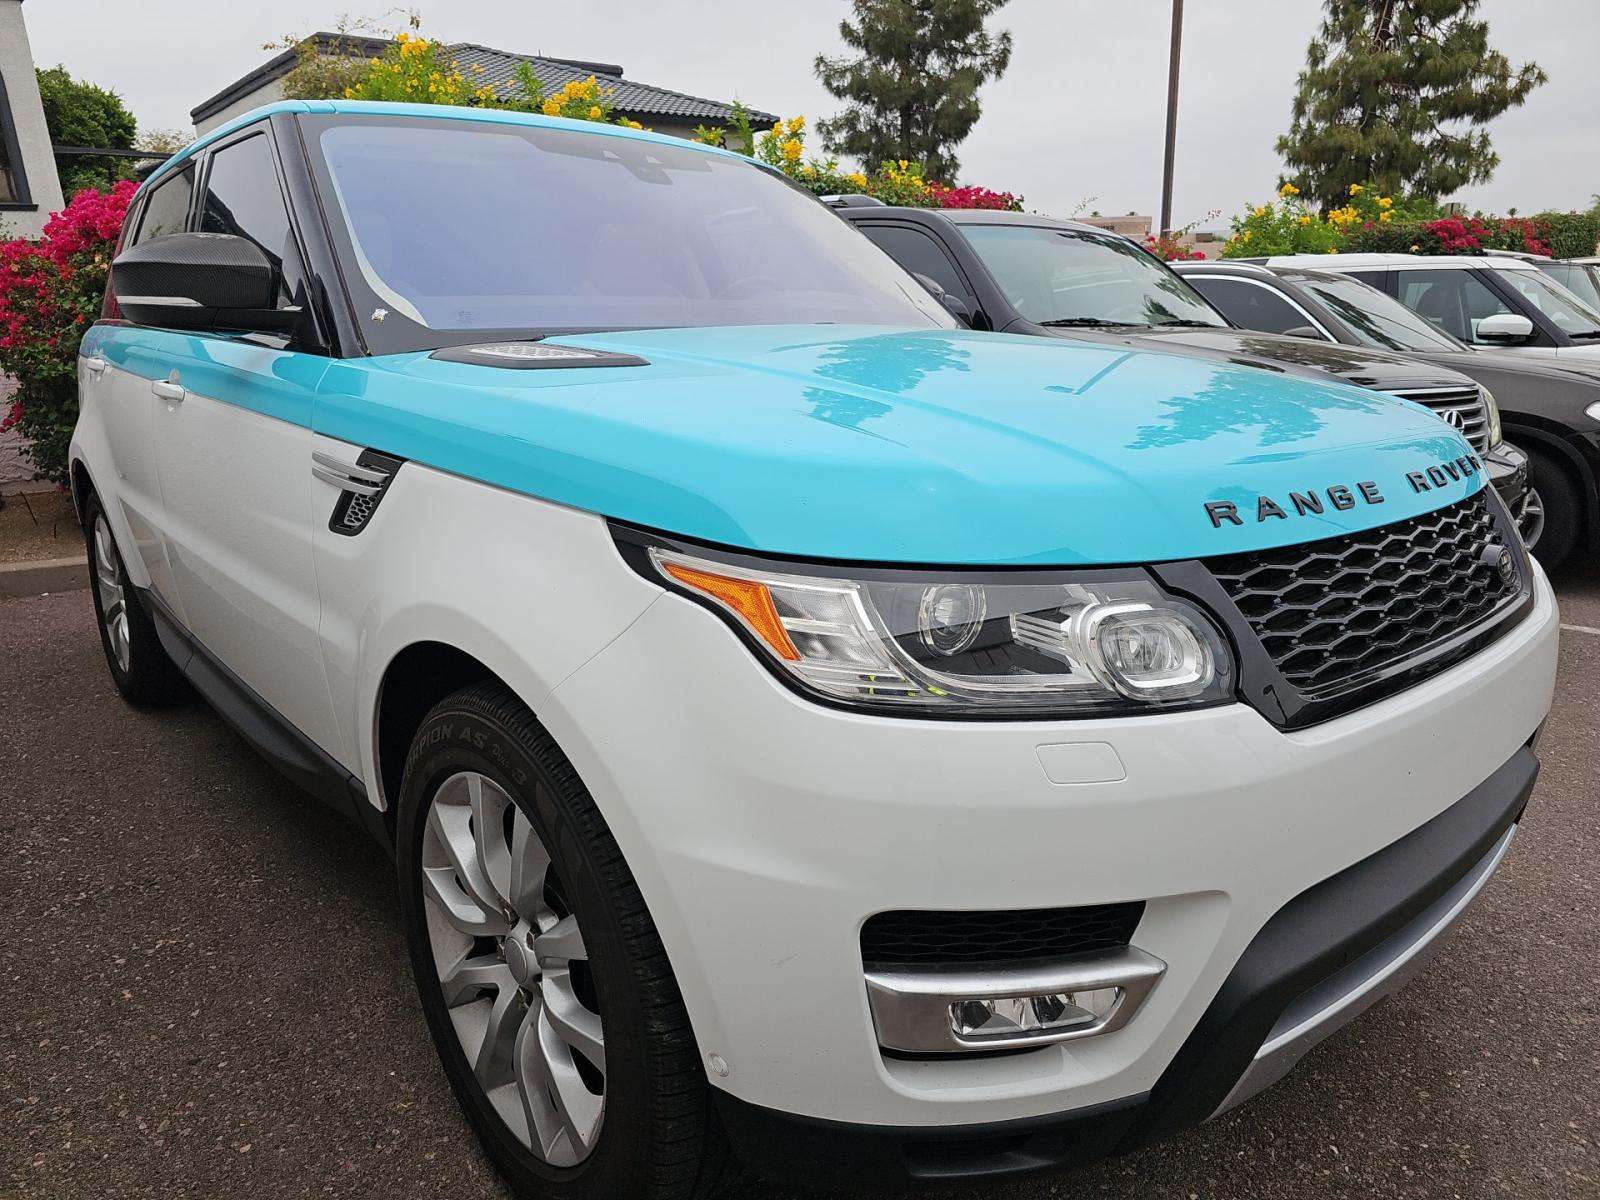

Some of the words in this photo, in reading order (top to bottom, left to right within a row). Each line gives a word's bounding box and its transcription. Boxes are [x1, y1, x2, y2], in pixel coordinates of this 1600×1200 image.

[1204, 480, 1385, 528] RANGE
[1406, 455, 1481, 493] ROVER
[458, 726, 488, 750] AS
